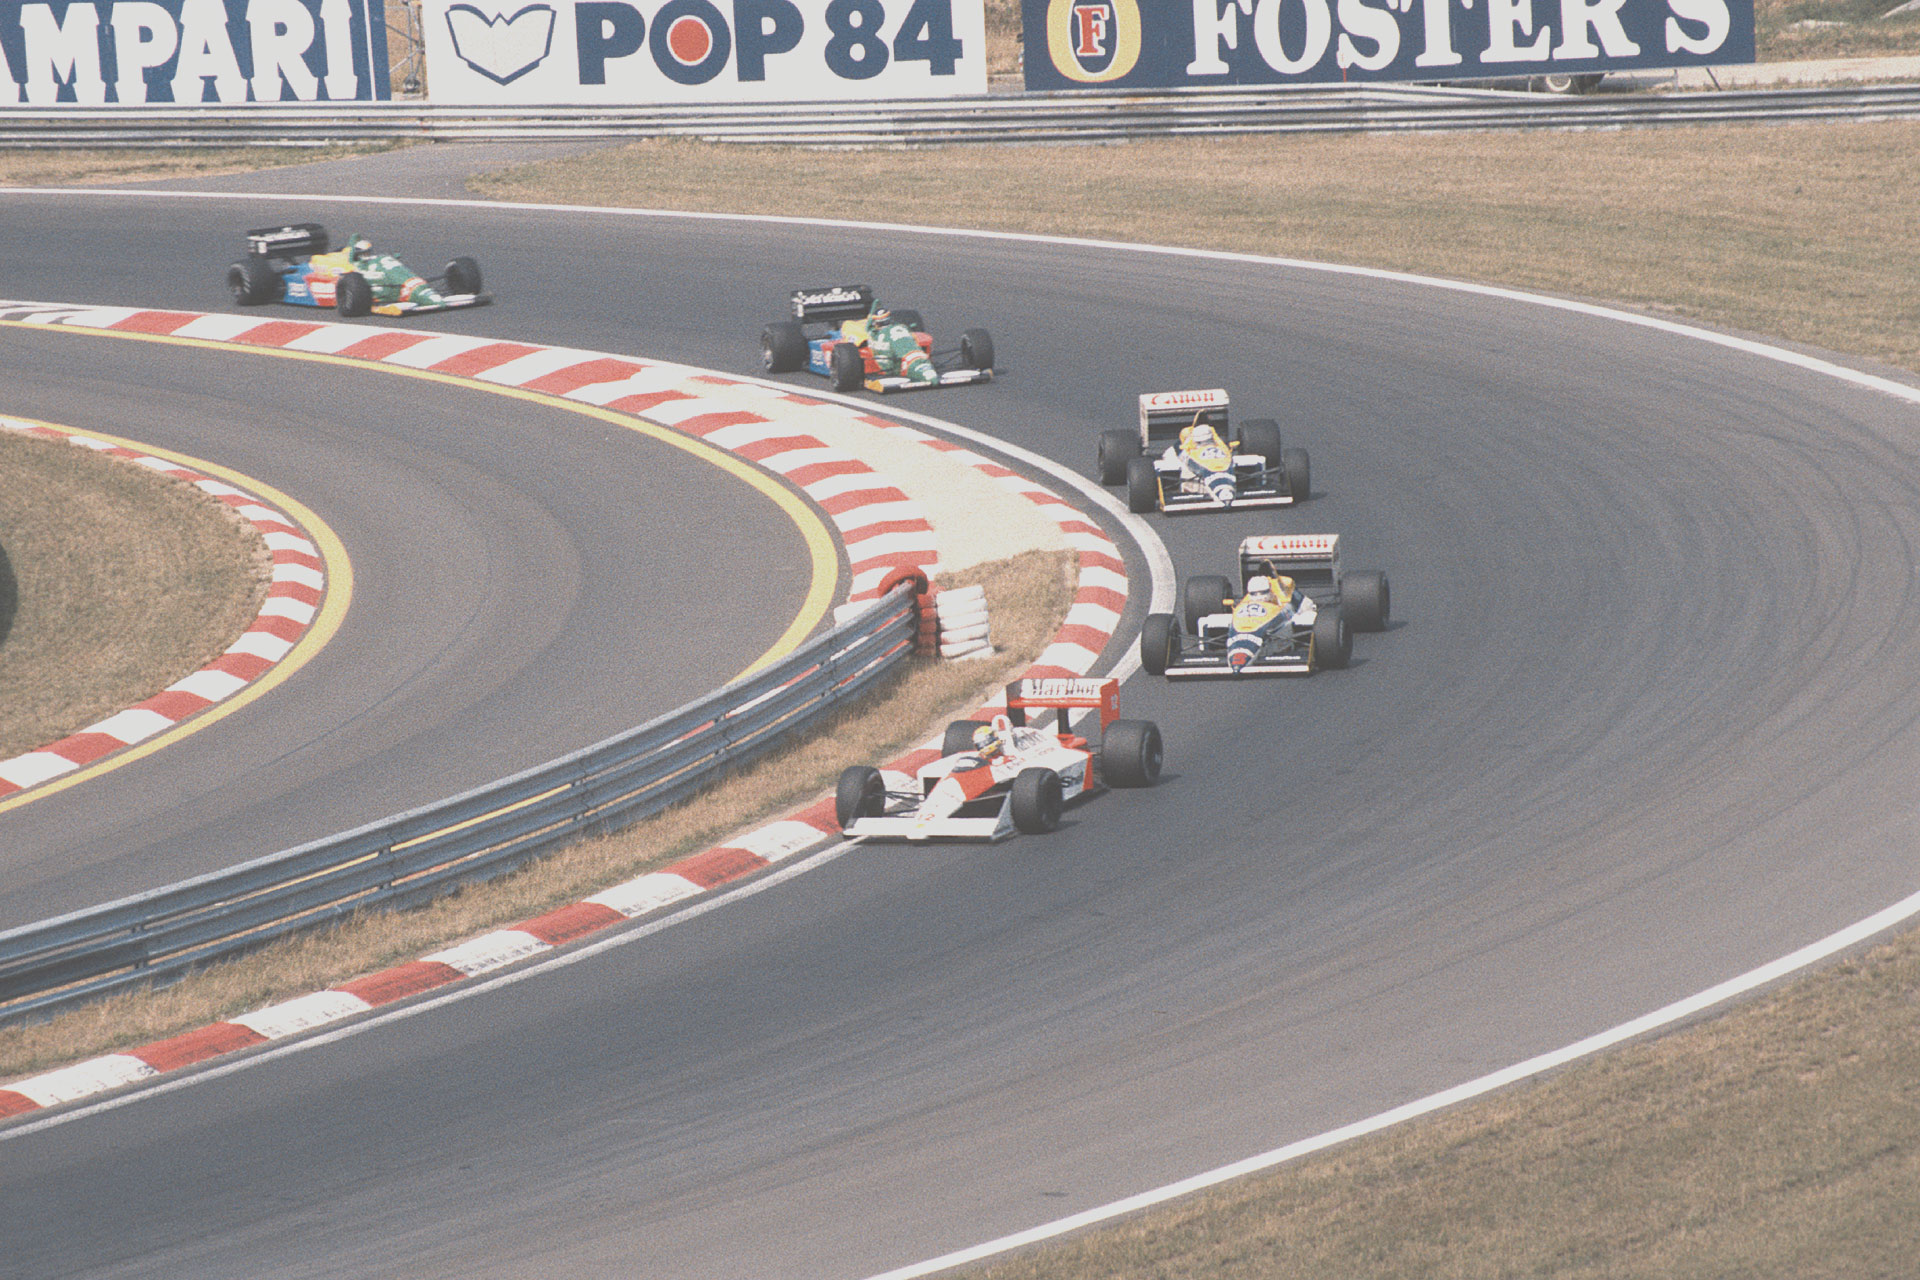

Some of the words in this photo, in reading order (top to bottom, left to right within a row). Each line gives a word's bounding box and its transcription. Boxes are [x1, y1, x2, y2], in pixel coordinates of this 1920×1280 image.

[0, 0, 358, 102] MPARI
[574, 0, 805, 86] POP
[824, 0, 963, 81] 84
[1074, 4, 1110, 57] F
[1151, 393, 1215, 406] Canon
